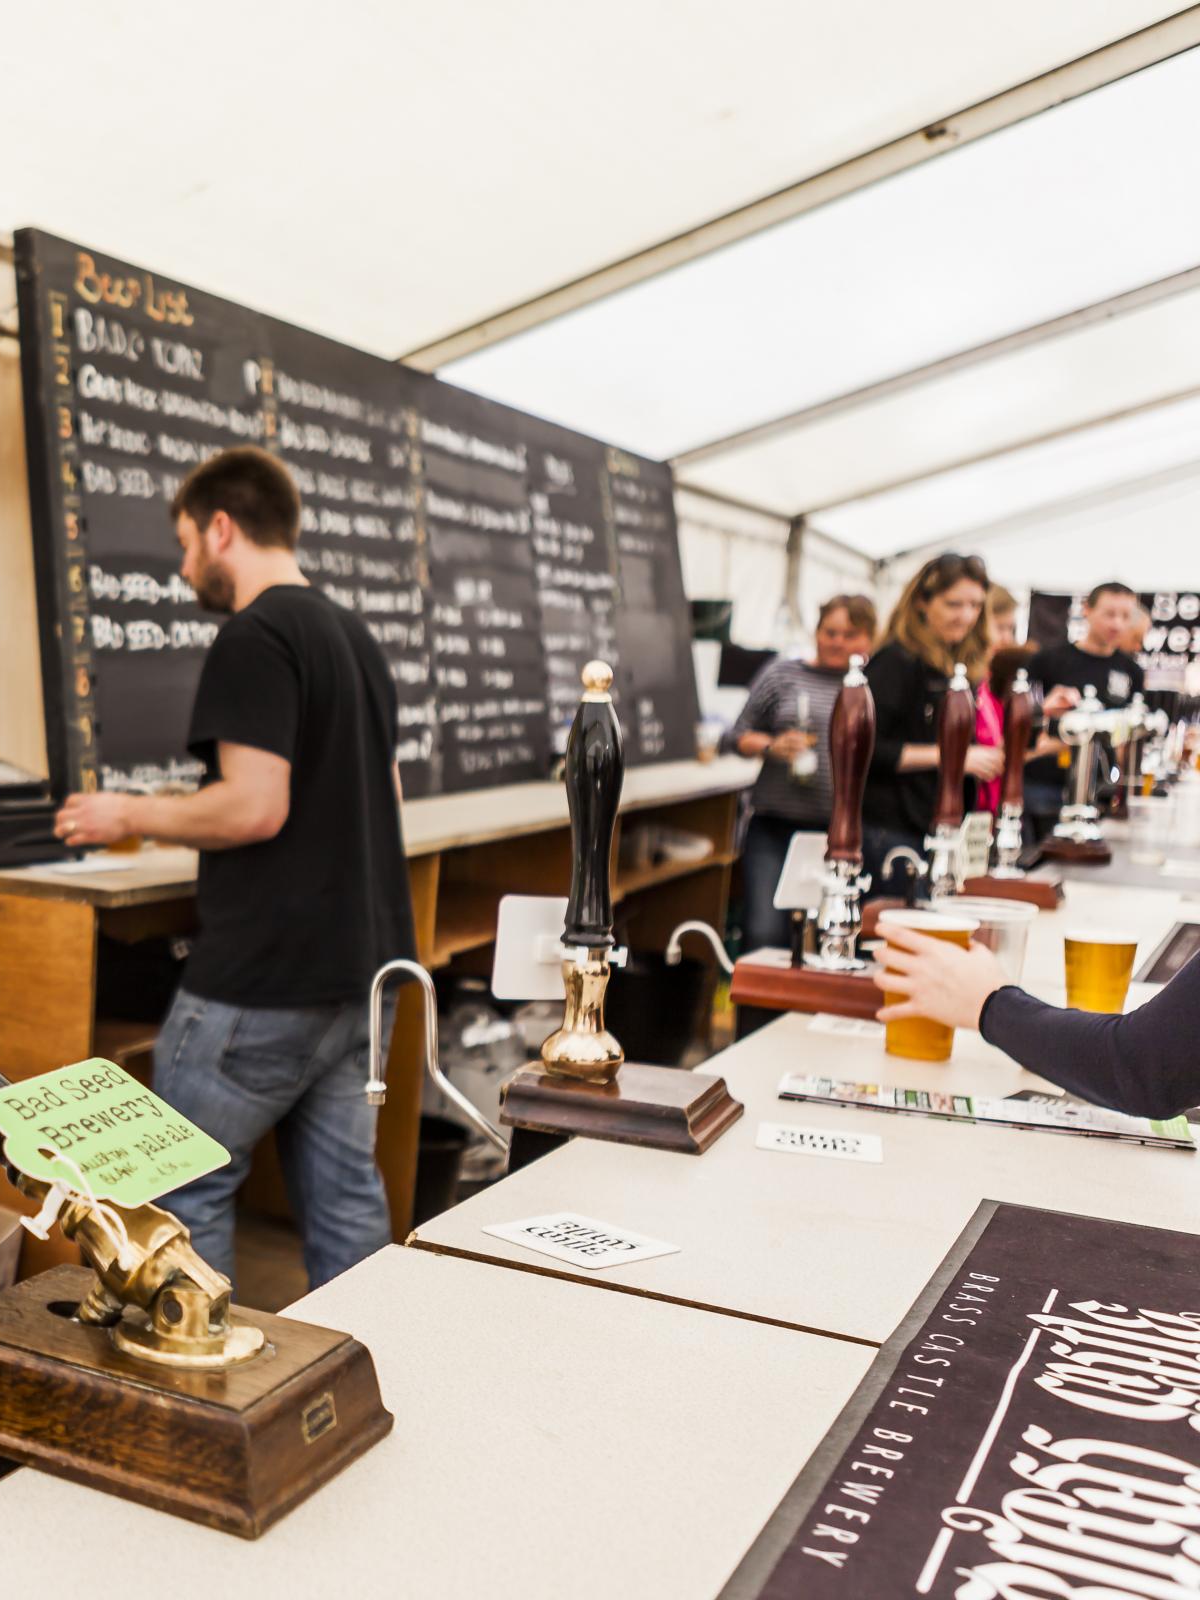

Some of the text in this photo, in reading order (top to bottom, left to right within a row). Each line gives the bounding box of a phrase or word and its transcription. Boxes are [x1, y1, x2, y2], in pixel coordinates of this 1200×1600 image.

[3, 1064, 129, 1120] Bad Seed
[38, 1094, 163, 1150] Brewery
[133, 1133, 172, 1161] pale
[166, 1123, 195, 1144] ale
[801, 1272, 1001, 1568] BRASS CASTLE BREWERY
